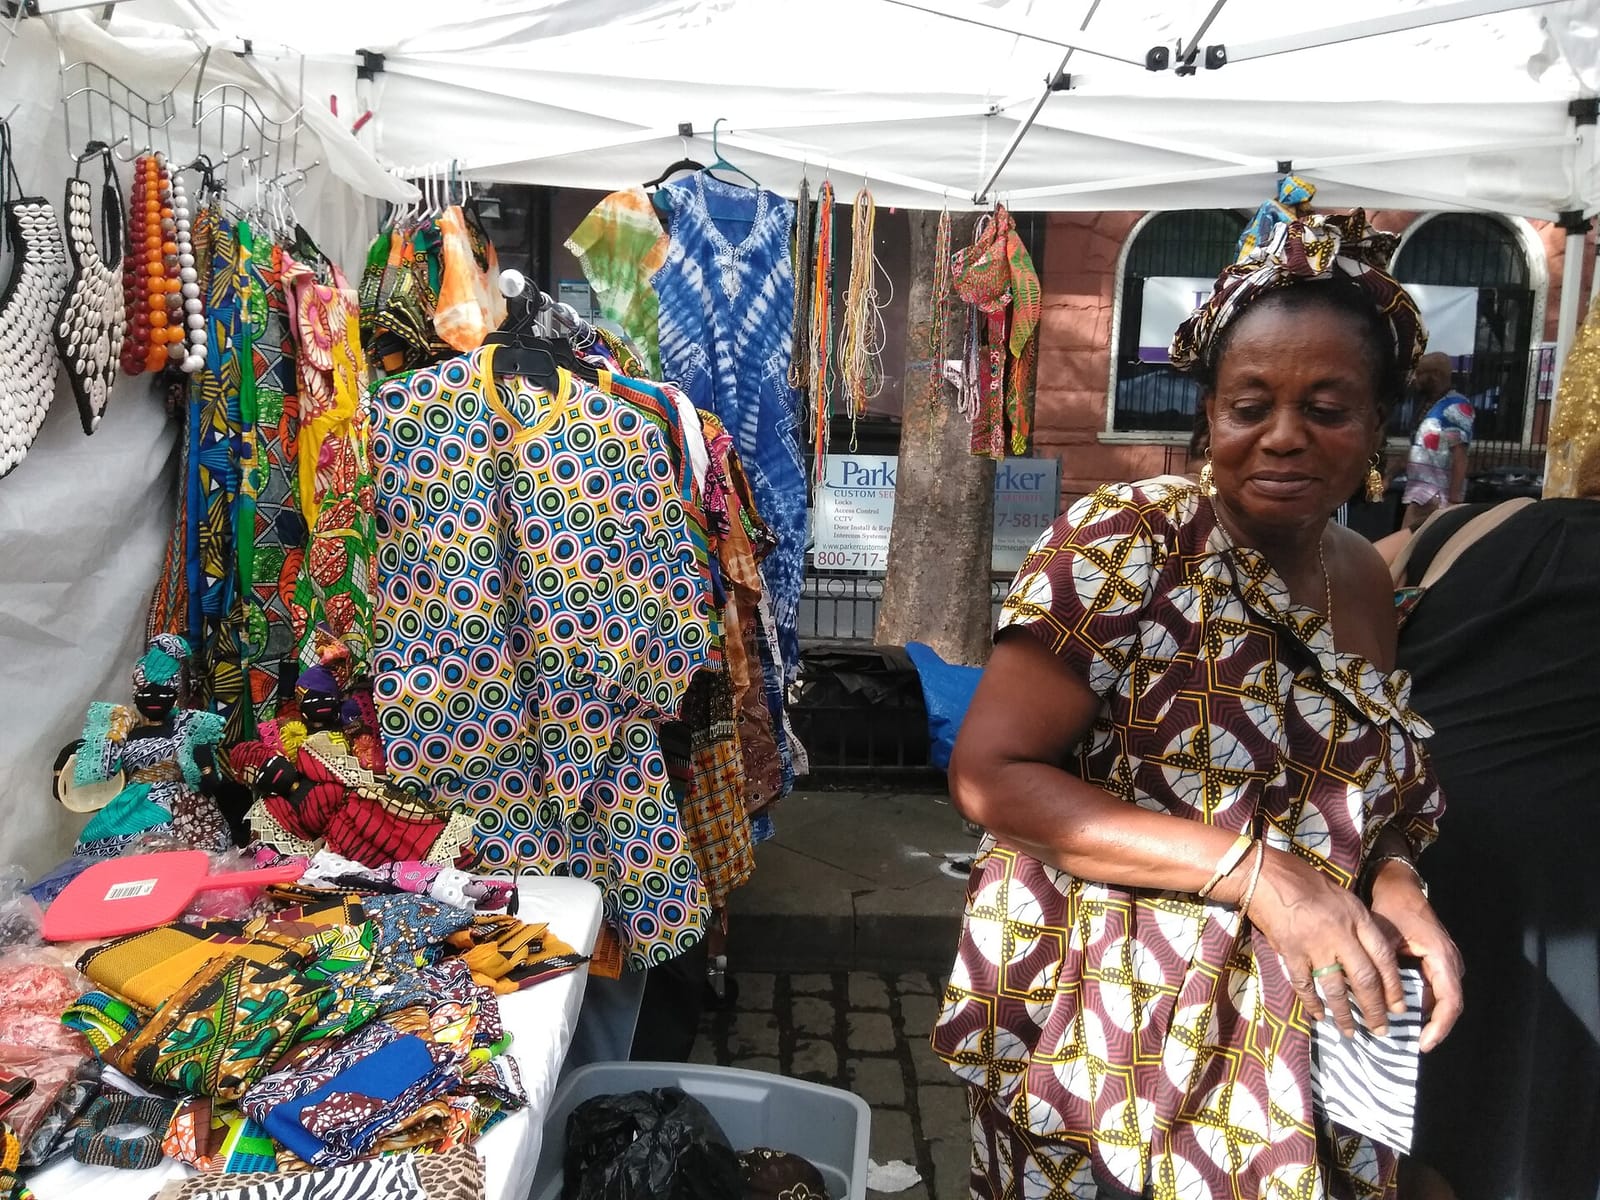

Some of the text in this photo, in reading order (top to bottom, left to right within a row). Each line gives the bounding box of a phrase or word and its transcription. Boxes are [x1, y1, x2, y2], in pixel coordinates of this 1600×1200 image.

[841, 460, 896, 486] Park
[996, 465, 1046, 490] rker
[834, 489, 876, 498] CUSTOM
[998, 512, 1049, 528] 7-5815
[818, 551, 889, 567] 800-717-
